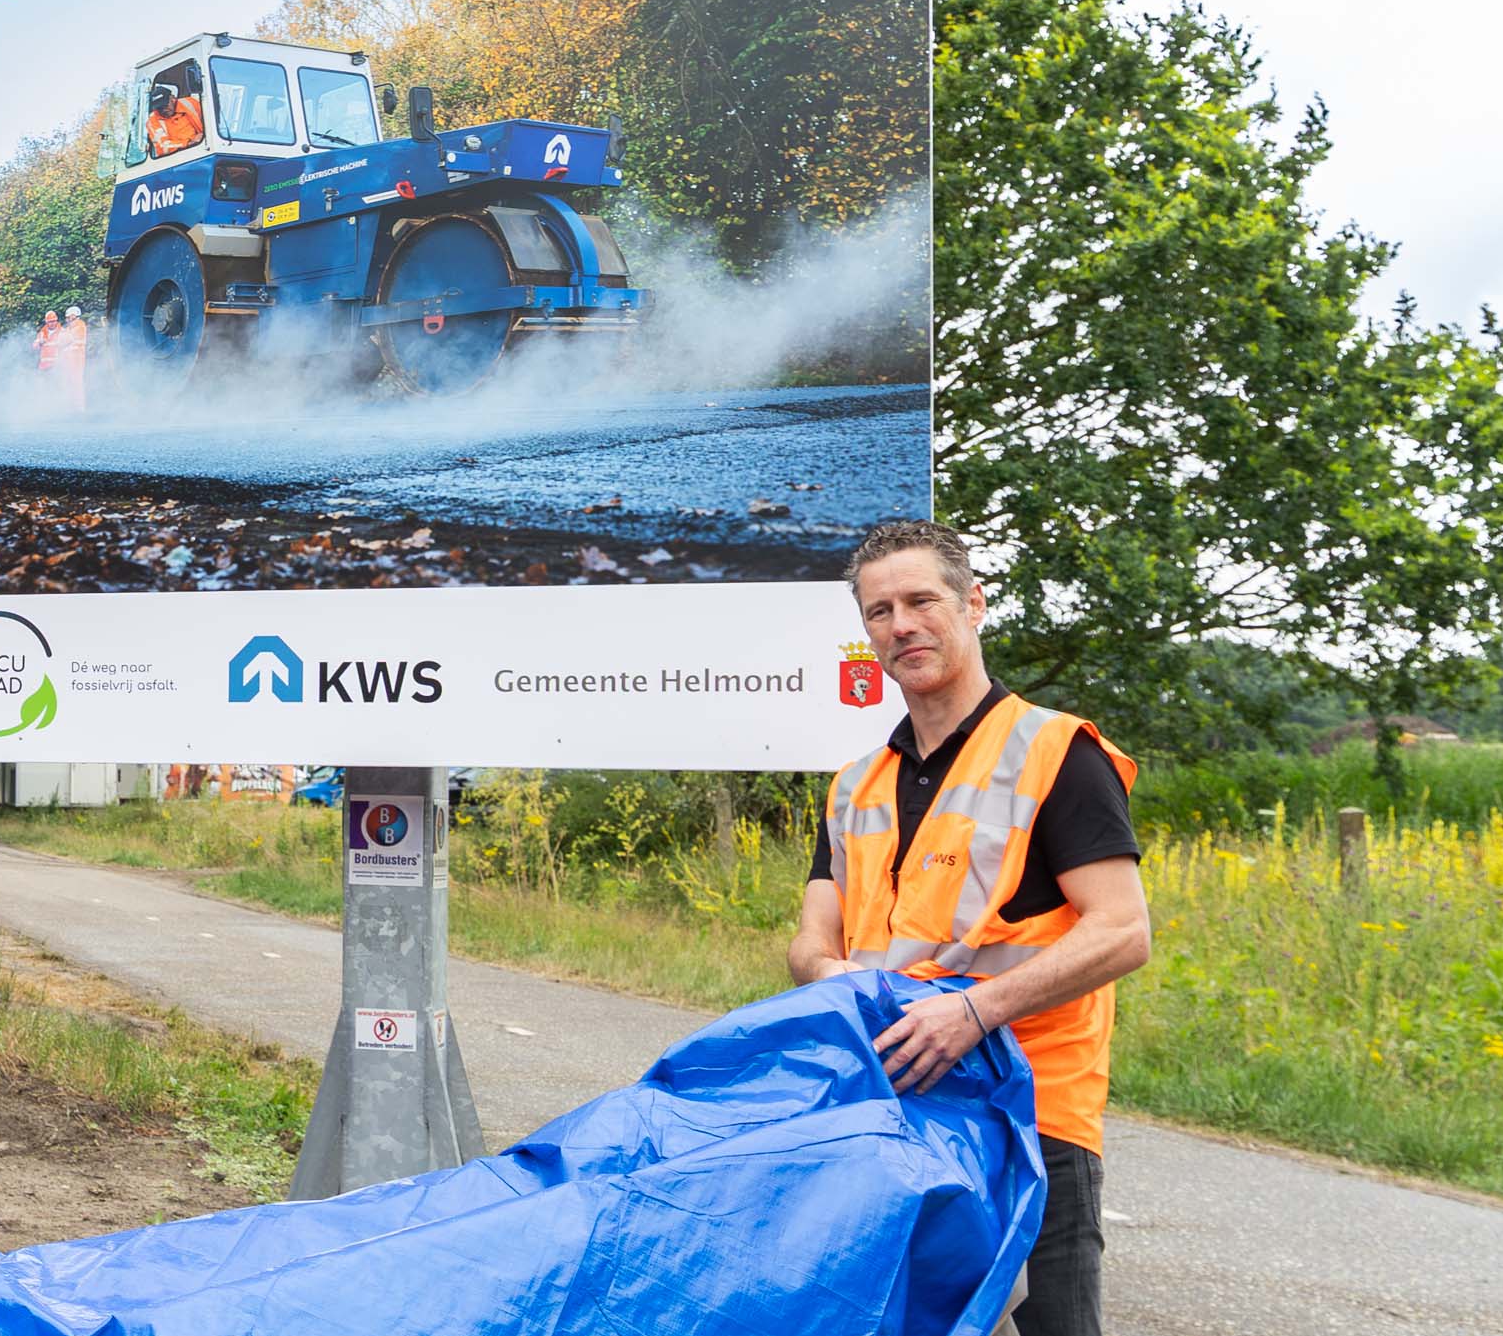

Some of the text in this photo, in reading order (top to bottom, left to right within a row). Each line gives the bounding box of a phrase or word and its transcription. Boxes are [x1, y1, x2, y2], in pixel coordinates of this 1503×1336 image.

[151, 183, 185, 211] KWS
[70, 661, 154, 676] Dé weg naar
[70, 679, 179, 693] fossielvrij asfalt.
[318, 659, 444, 704] KWS
[493, 667, 805, 694] Gemeente Helmond
[379, 807, 390, 824] B
[384, 827, 395, 844] B
[933, 852, 957, 867] WS
